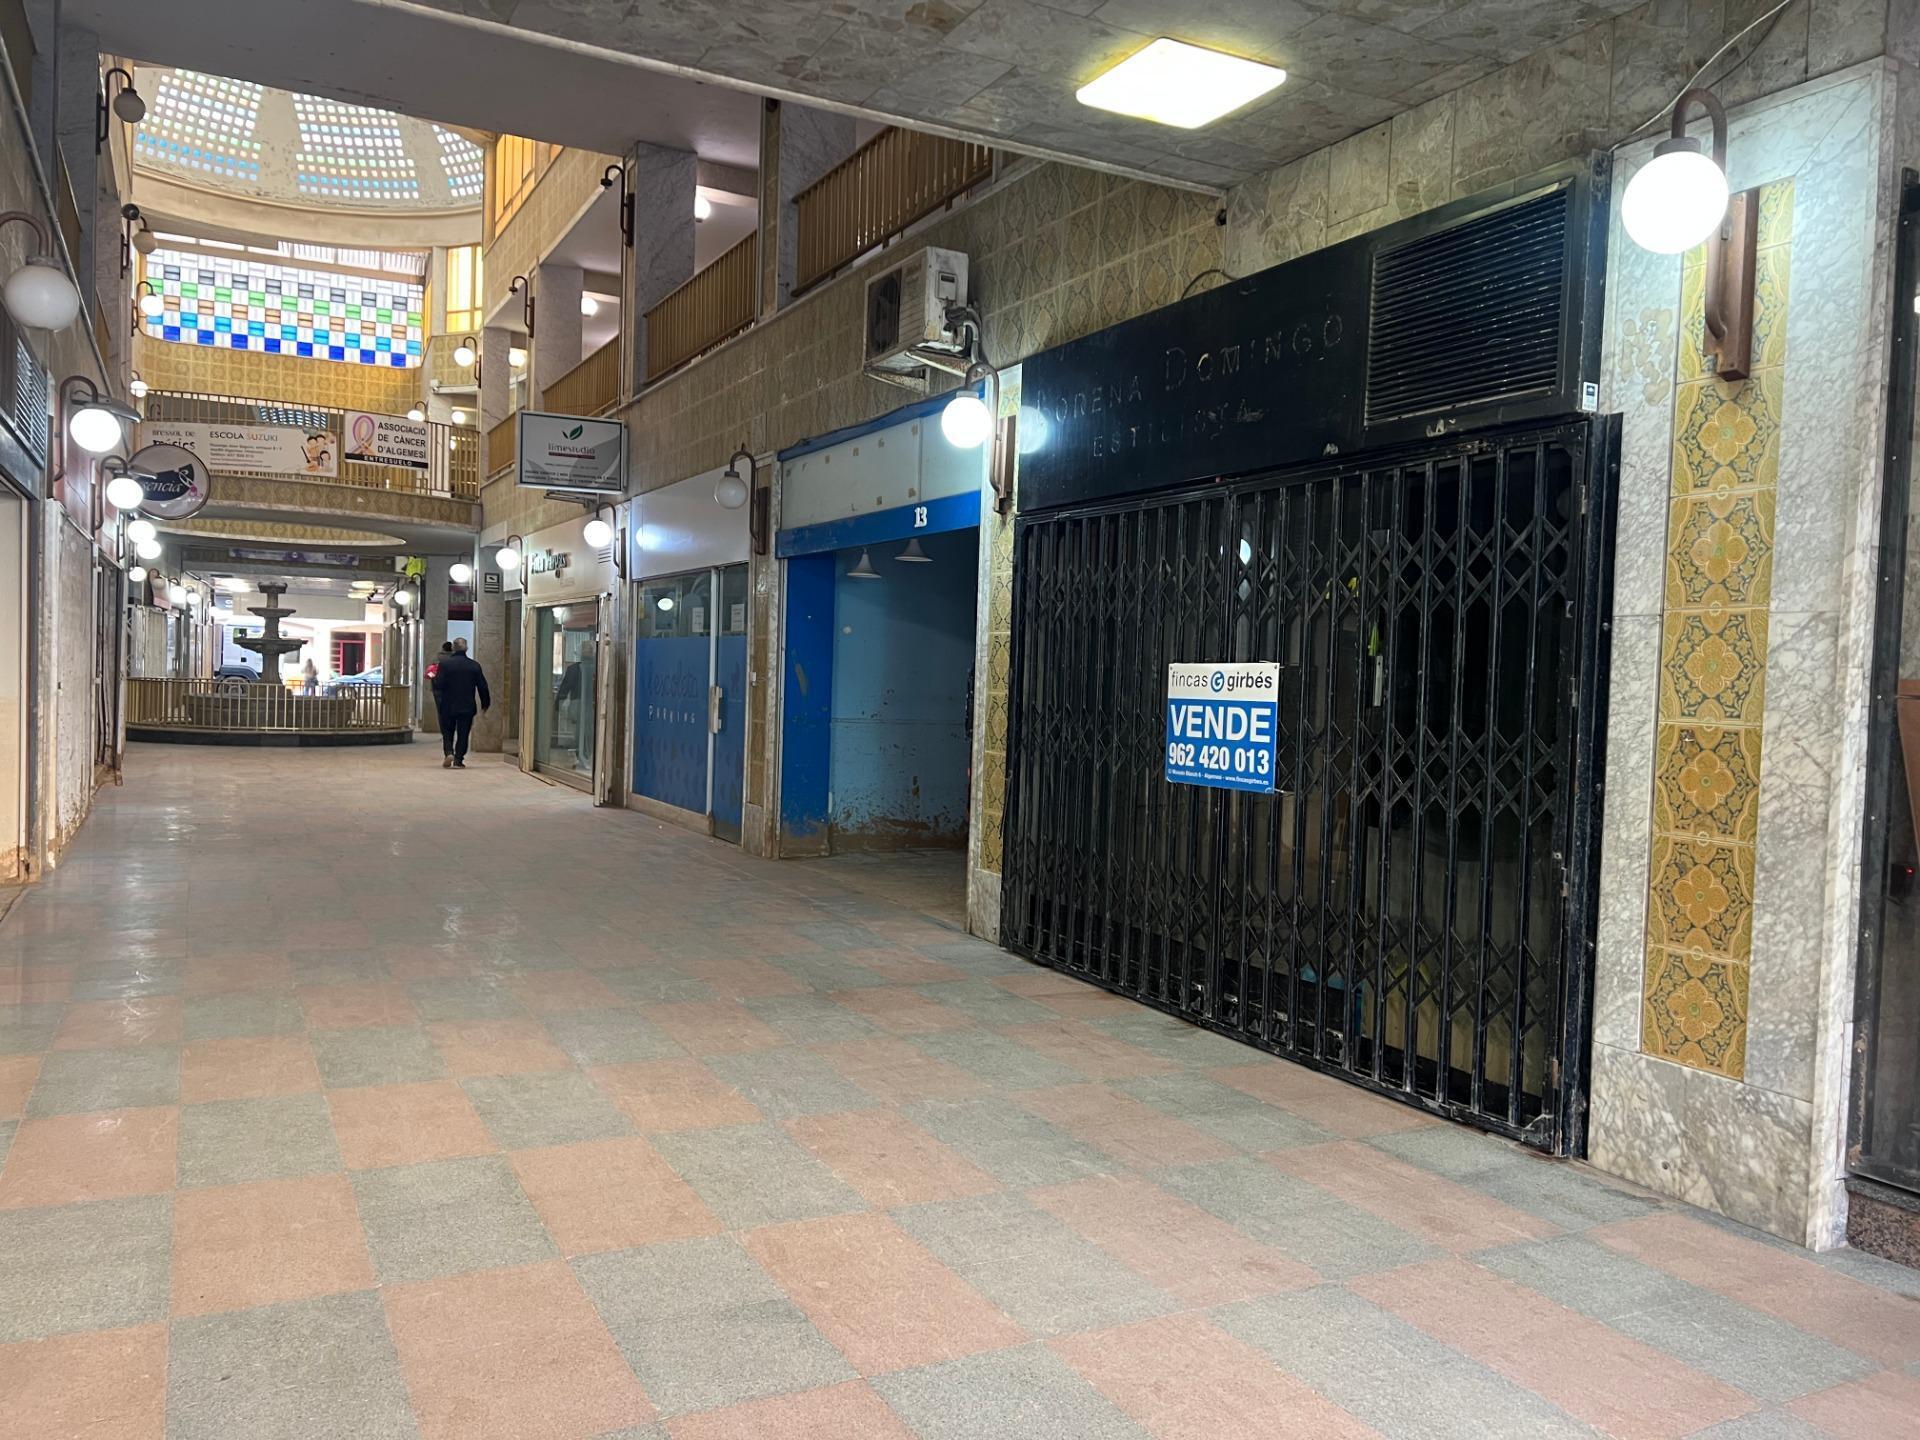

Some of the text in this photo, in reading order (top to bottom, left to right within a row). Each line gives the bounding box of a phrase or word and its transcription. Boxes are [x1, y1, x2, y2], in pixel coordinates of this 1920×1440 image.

[1164, 314, 1343, 391] DOMINGO
[209, 431, 278, 441] ESCOLA SUZUKI
[377, 422, 426, 435] ASSOCIACIÓ
[377, 433, 426, 447] DE CÀNCER
[547, 442, 595, 454] limestudio
[364, 456, 412, 466] ENTRESUELO
[914, 506, 928, 528] 13
[1171, 671, 1208, 688] fincas
[1227, 671, 1273, 692] girbés
[1170, 704, 1272, 743] VENDE
[1168, 742, 1270, 775] 962 420 013
